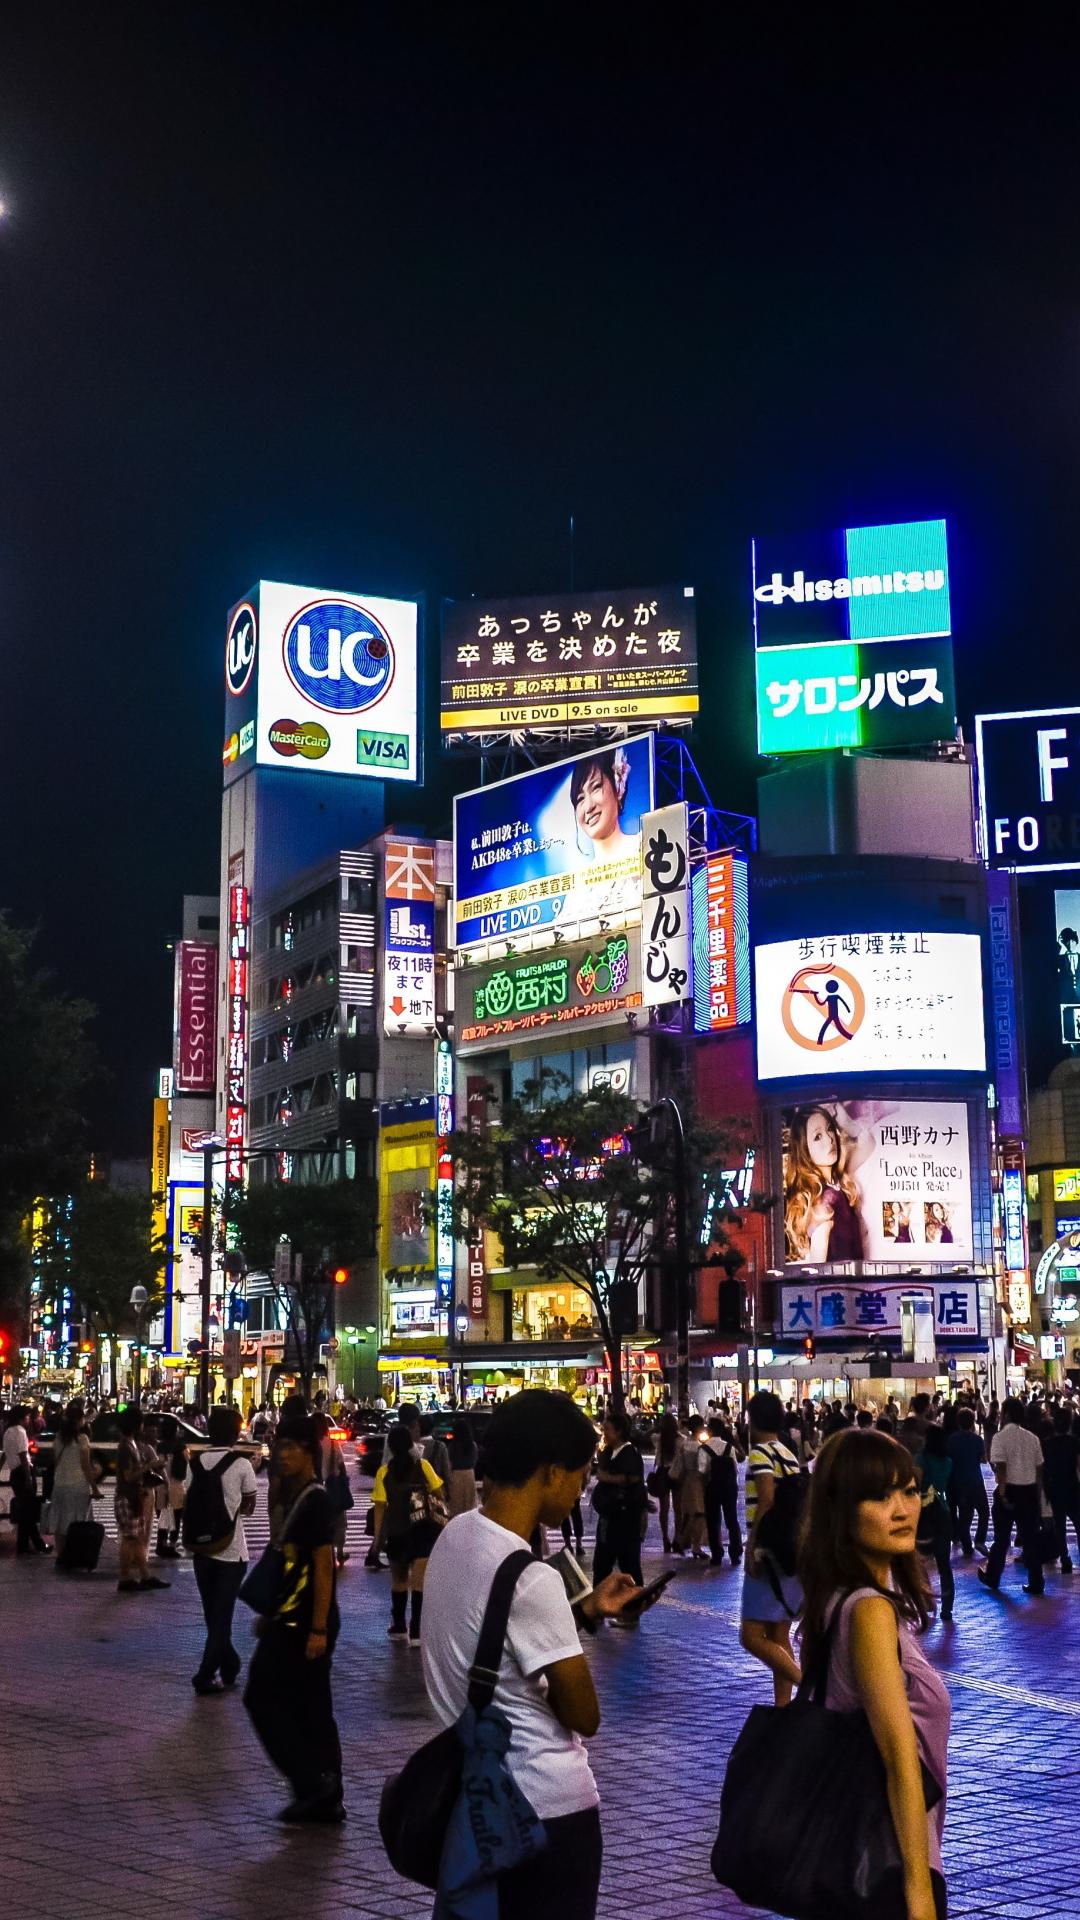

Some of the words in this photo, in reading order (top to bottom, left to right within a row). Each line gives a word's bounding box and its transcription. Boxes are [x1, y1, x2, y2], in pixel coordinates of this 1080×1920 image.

[755, 570, 945, 604] Hisamitsu
[478, 600, 659, 638] あっちゃんが
[229, 622, 254, 675] UC
[297, 623, 387, 687] UC
[457, 629, 682, 668] 卒業を決めた夜
[452, 679, 508, 699] 前田敦子
[766, 667, 944, 717] サロンパス
[500, 706, 527, 721] LIVE
[531, 706, 559, 720] DVD
[572, 704, 592, 717] 9.5
[595, 706, 610, 715] on
[614, 703, 638, 714] sale
[270, 731, 329, 749] MasterCard
[362, 737, 408, 761] VISA
[385, 845, 435, 900] 本
[462, 893, 503, 918] 前田敦子
[480, 912, 508, 937] LIVE
[510, 904, 542, 930] DVD
[644, 828, 688, 996] もんじゃ
[708, 864, 729, 1020] 三千里薬品
[798, 931, 931, 960] 歩行喫煙禁止
[387, 955, 433, 973] 夜11時
[396, 974, 424, 990] まで
[515, 972, 568, 1011] 西村
[182, 947, 207, 1086] Essential
[409, 999, 433, 1017] 地下
[880, 1125, 960, 1146] 西野カナ
[788, 1290, 969, 1329] 大盛堂店
